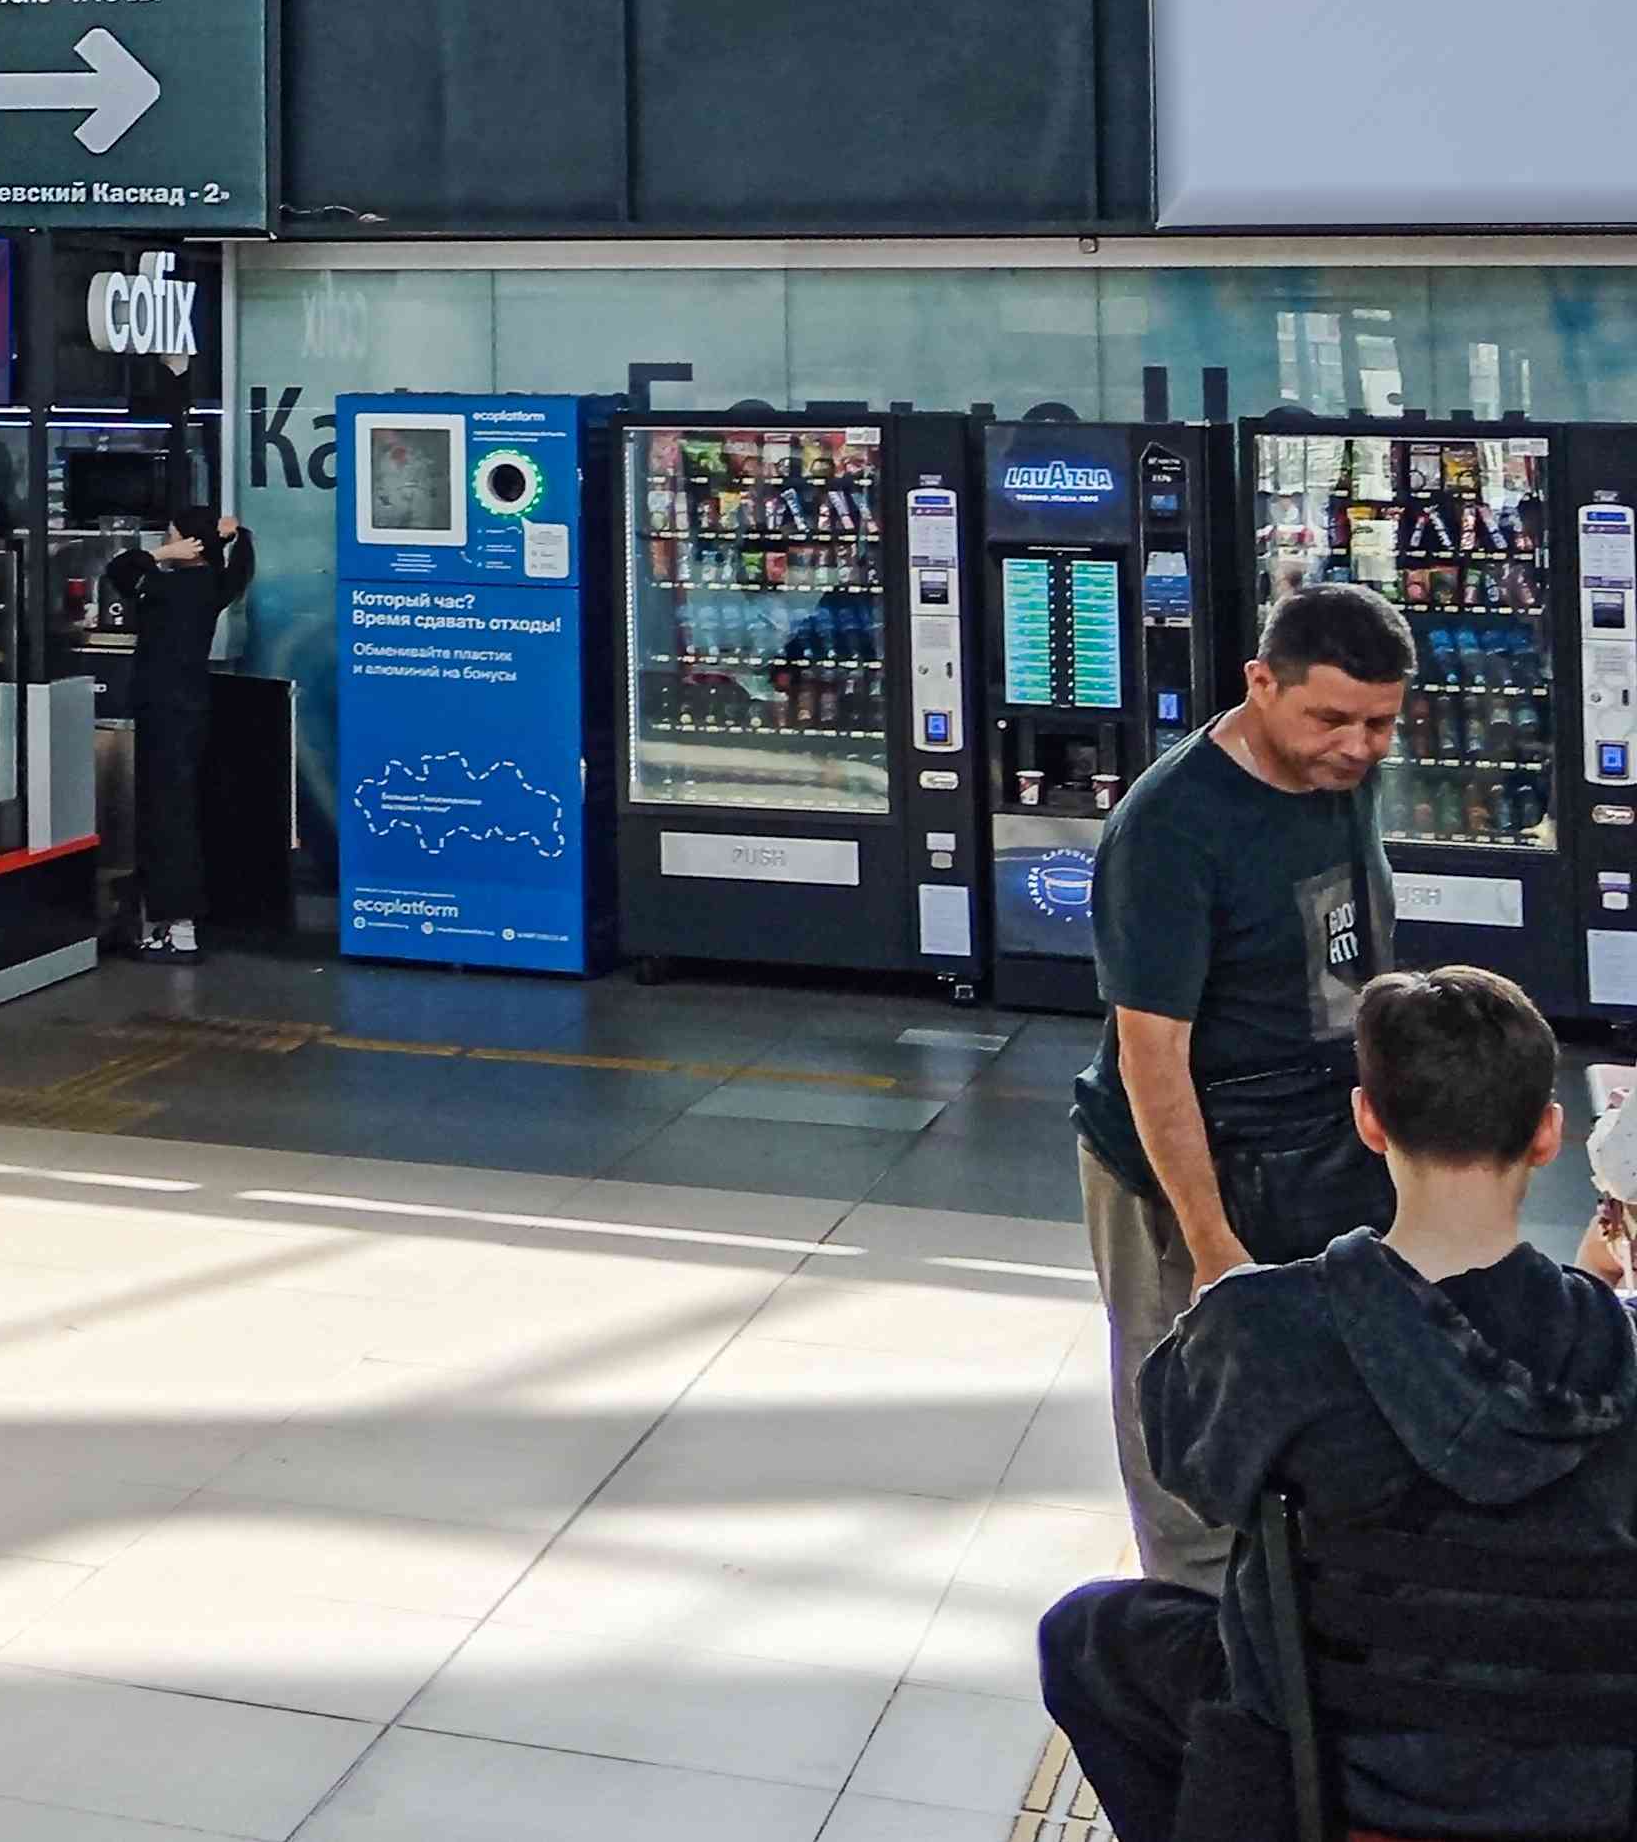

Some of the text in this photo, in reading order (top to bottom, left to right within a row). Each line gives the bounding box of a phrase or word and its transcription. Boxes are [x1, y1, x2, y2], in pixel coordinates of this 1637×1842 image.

[92, 183, 186, 207] Каскад
[203, 183, 230, 204] 2»
[101, 251, 198, 356] cofix
[1004, 460, 1114, 491] LAVAZZA
[352, 589, 476, 610] Который час?
[352, 609, 562, 634] Время сдавать отходы!
[352, 642, 513, 663] Обменивайте пластик
[463, 666, 518, 684] бонусы
[352, 898, 460, 919] ecoplatform
